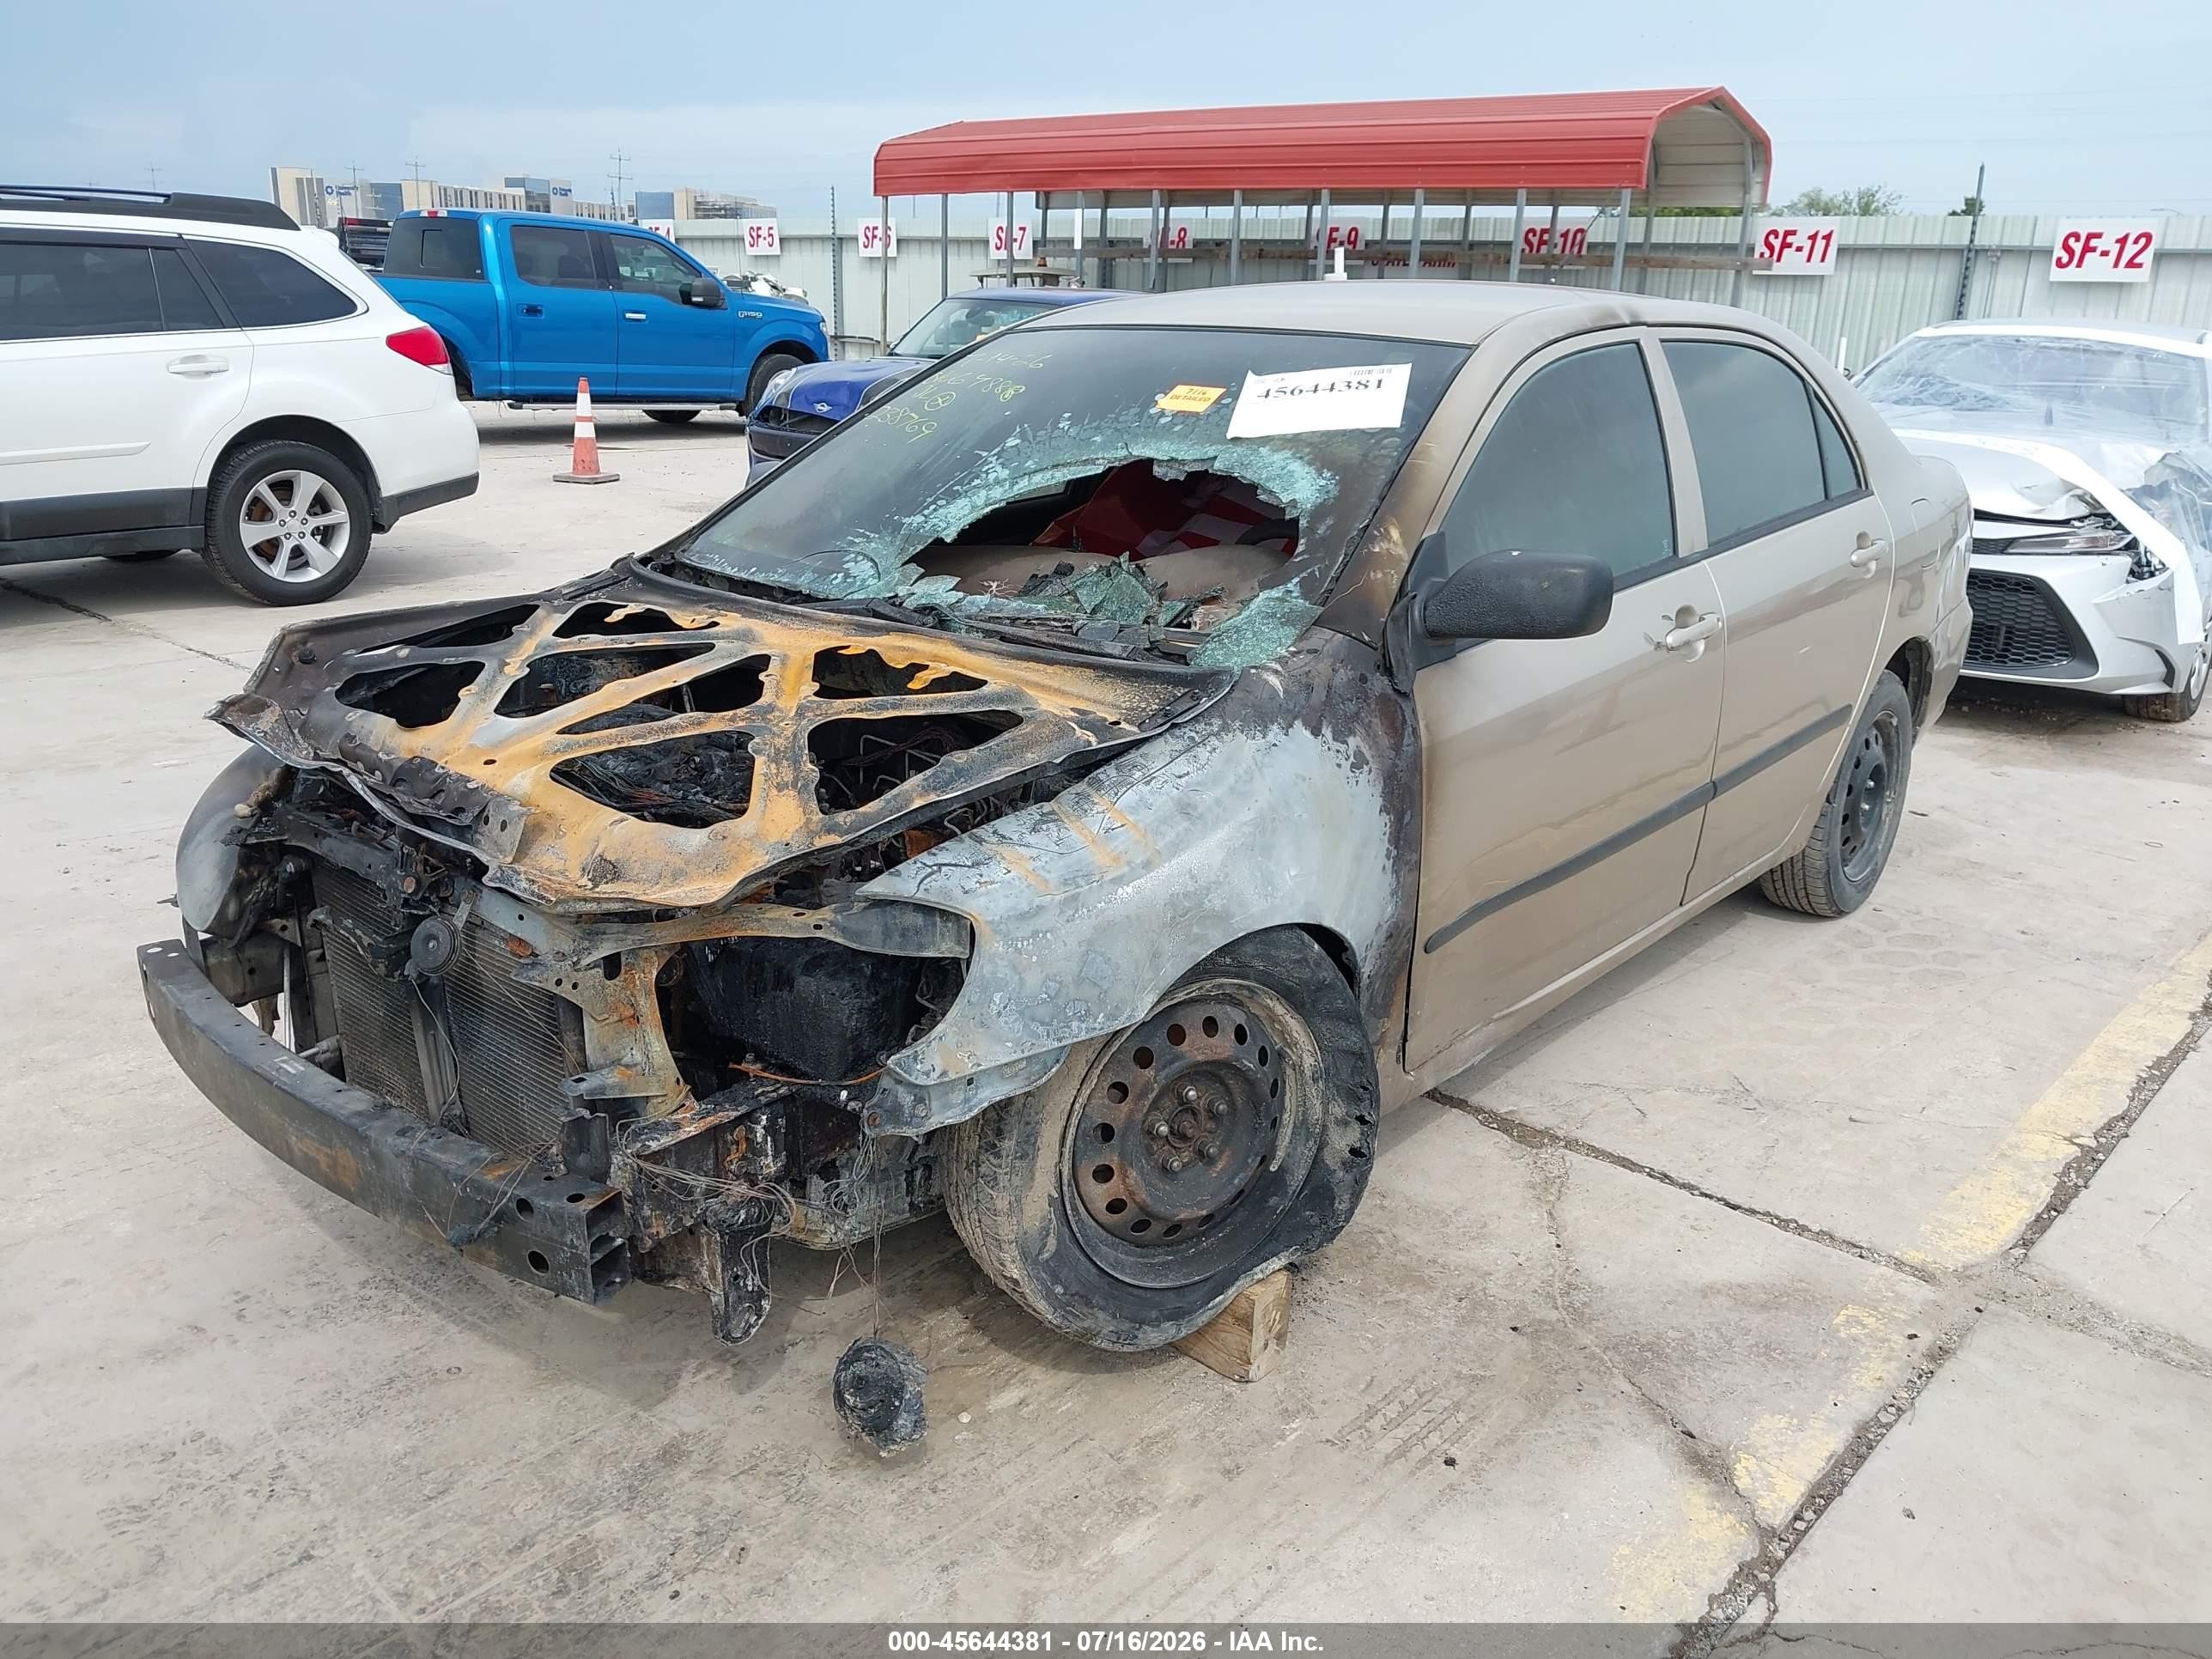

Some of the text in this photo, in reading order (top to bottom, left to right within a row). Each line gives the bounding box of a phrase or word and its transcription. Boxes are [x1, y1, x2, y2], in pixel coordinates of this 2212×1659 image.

[748, 225, 775, 248] SF-5
[1315, 226, 1359, 251] F-9
[1759, 228, 1835, 264] SF-11
[2055, 230, 2154, 270] SF-12
[1169, 393, 1212, 403] DETAILED
[1256, 378, 1384, 399] 45644381
